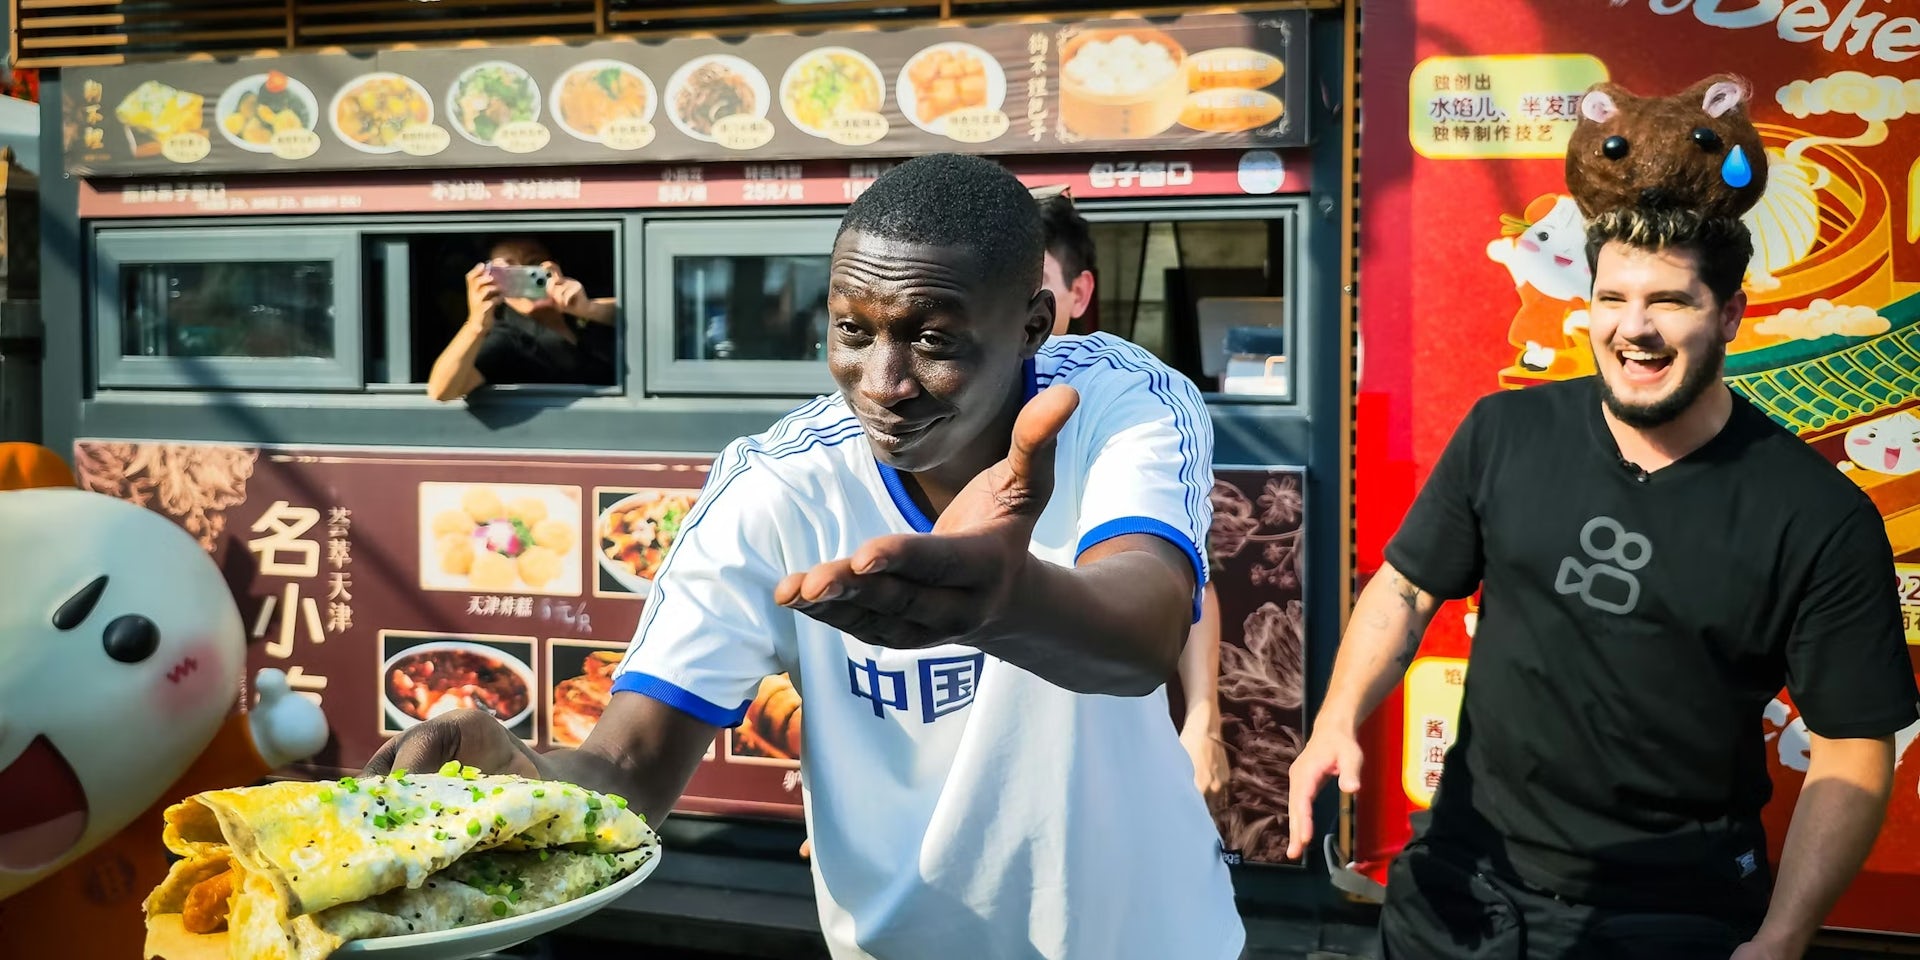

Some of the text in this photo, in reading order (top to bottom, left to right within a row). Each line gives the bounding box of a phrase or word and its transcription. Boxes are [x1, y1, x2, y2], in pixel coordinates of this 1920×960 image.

[1434, 75, 1491, 90] 独创出
[1433, 125, 1553, 142] 独特制作技艺
[328, 506, 353, 633] 荟萃天津
[847, 652, 986, 723] 中国
